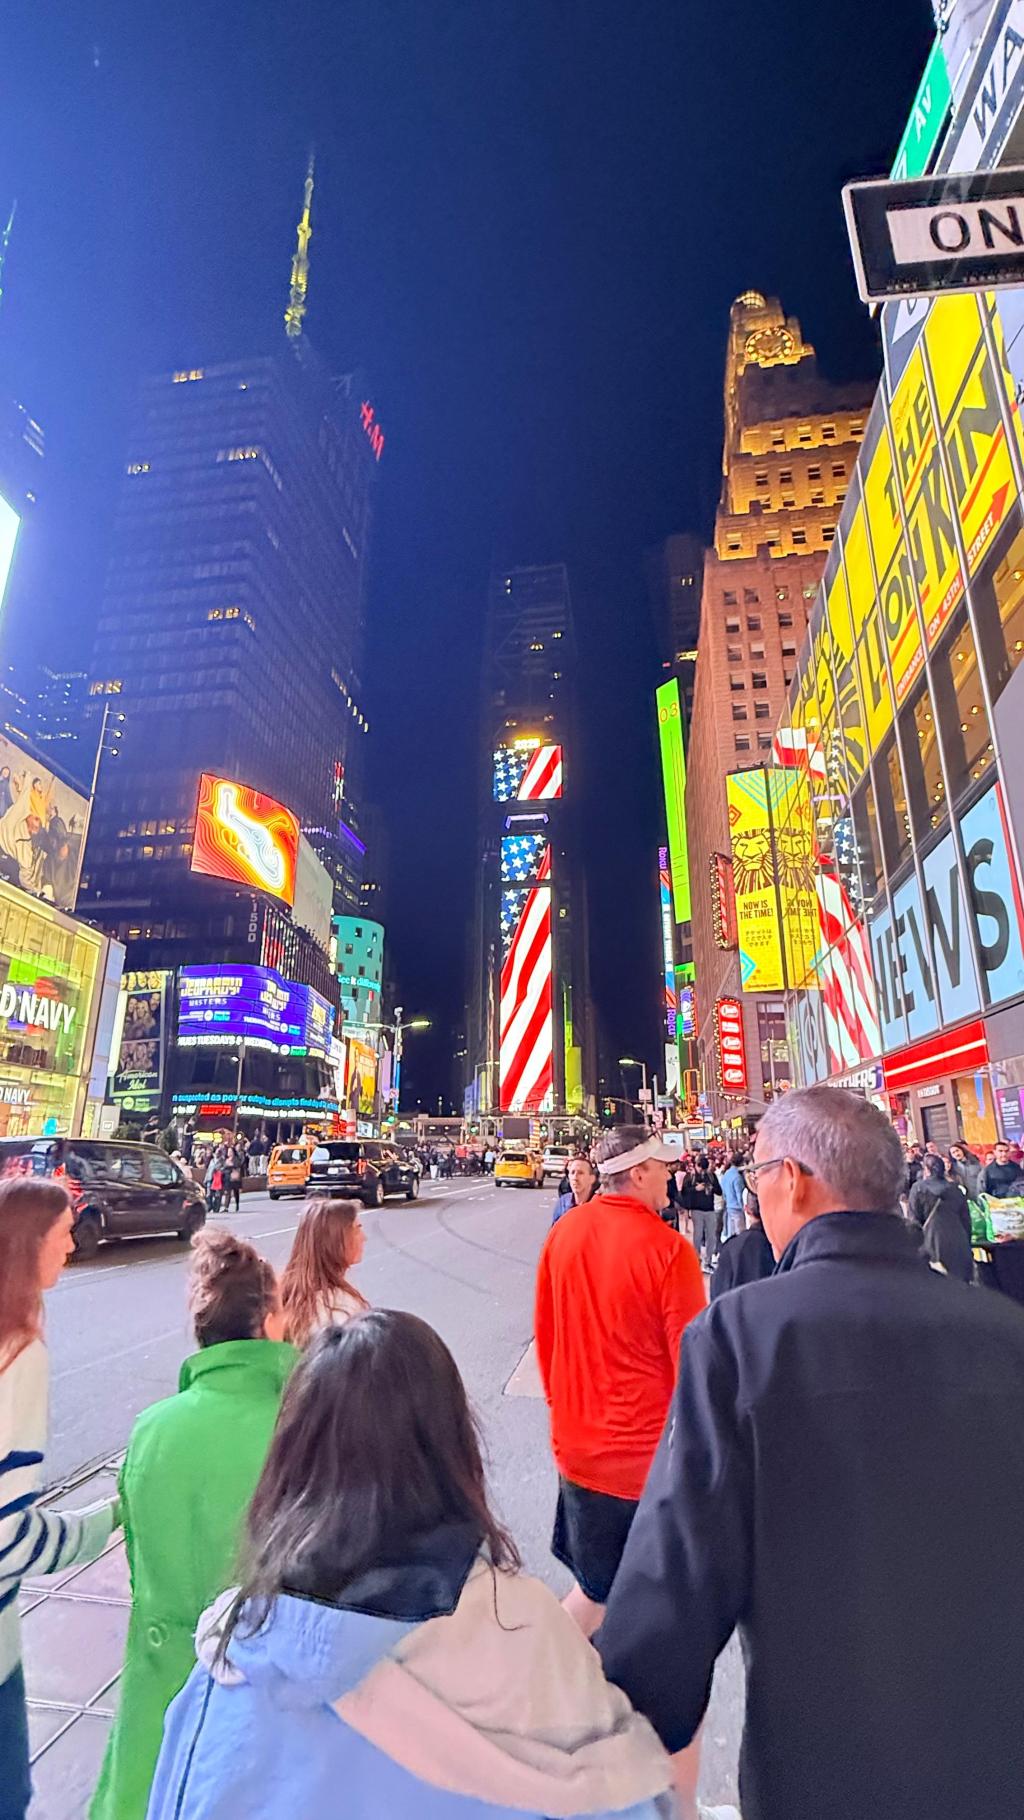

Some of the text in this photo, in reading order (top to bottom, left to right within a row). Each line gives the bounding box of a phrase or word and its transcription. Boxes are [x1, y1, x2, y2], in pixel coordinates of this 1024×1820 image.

[915, 83, 932, 144] AV
[884, 381, 932, 520] THE
[929, 613, 941, 637] ON
[966, 511, 994, 568] STREET
[740, 908, 774, 920] THE TIME!
[743, 899, 768, 910] NOW IS
[248, 902, 258, 943] 1500
[19, 991, 76, 1034] NAVY
[116, 1069, 158, 1083] American
[127, 1079, 147, 1090] Idol
[4, 1087, 31, 1105] NAVY
